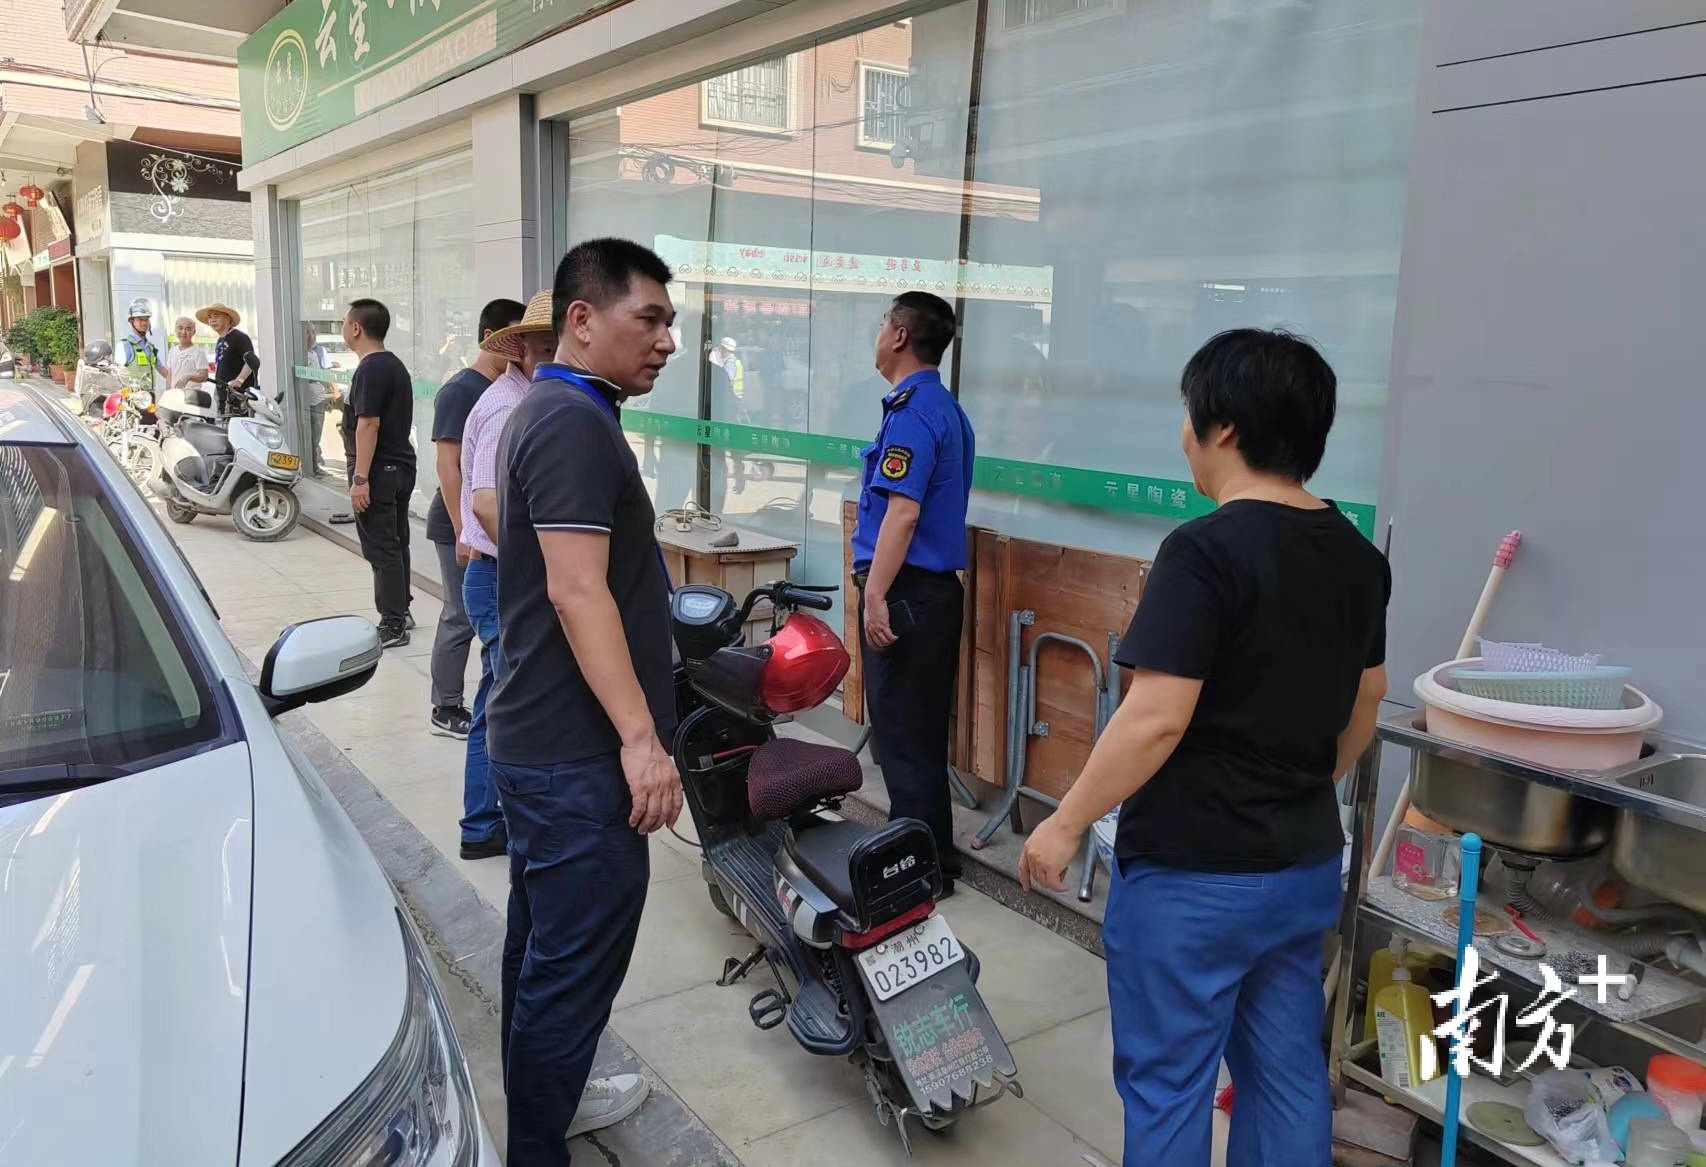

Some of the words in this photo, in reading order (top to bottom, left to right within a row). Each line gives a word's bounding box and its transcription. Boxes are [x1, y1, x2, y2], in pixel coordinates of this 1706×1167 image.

[1104, 479, 1187, 509] 云星陶瓷
[890, 932, 920, 954] 潮州
[874, 937, 958, 993] 023982
[919, 1054, 993, 1095] 15907688238
